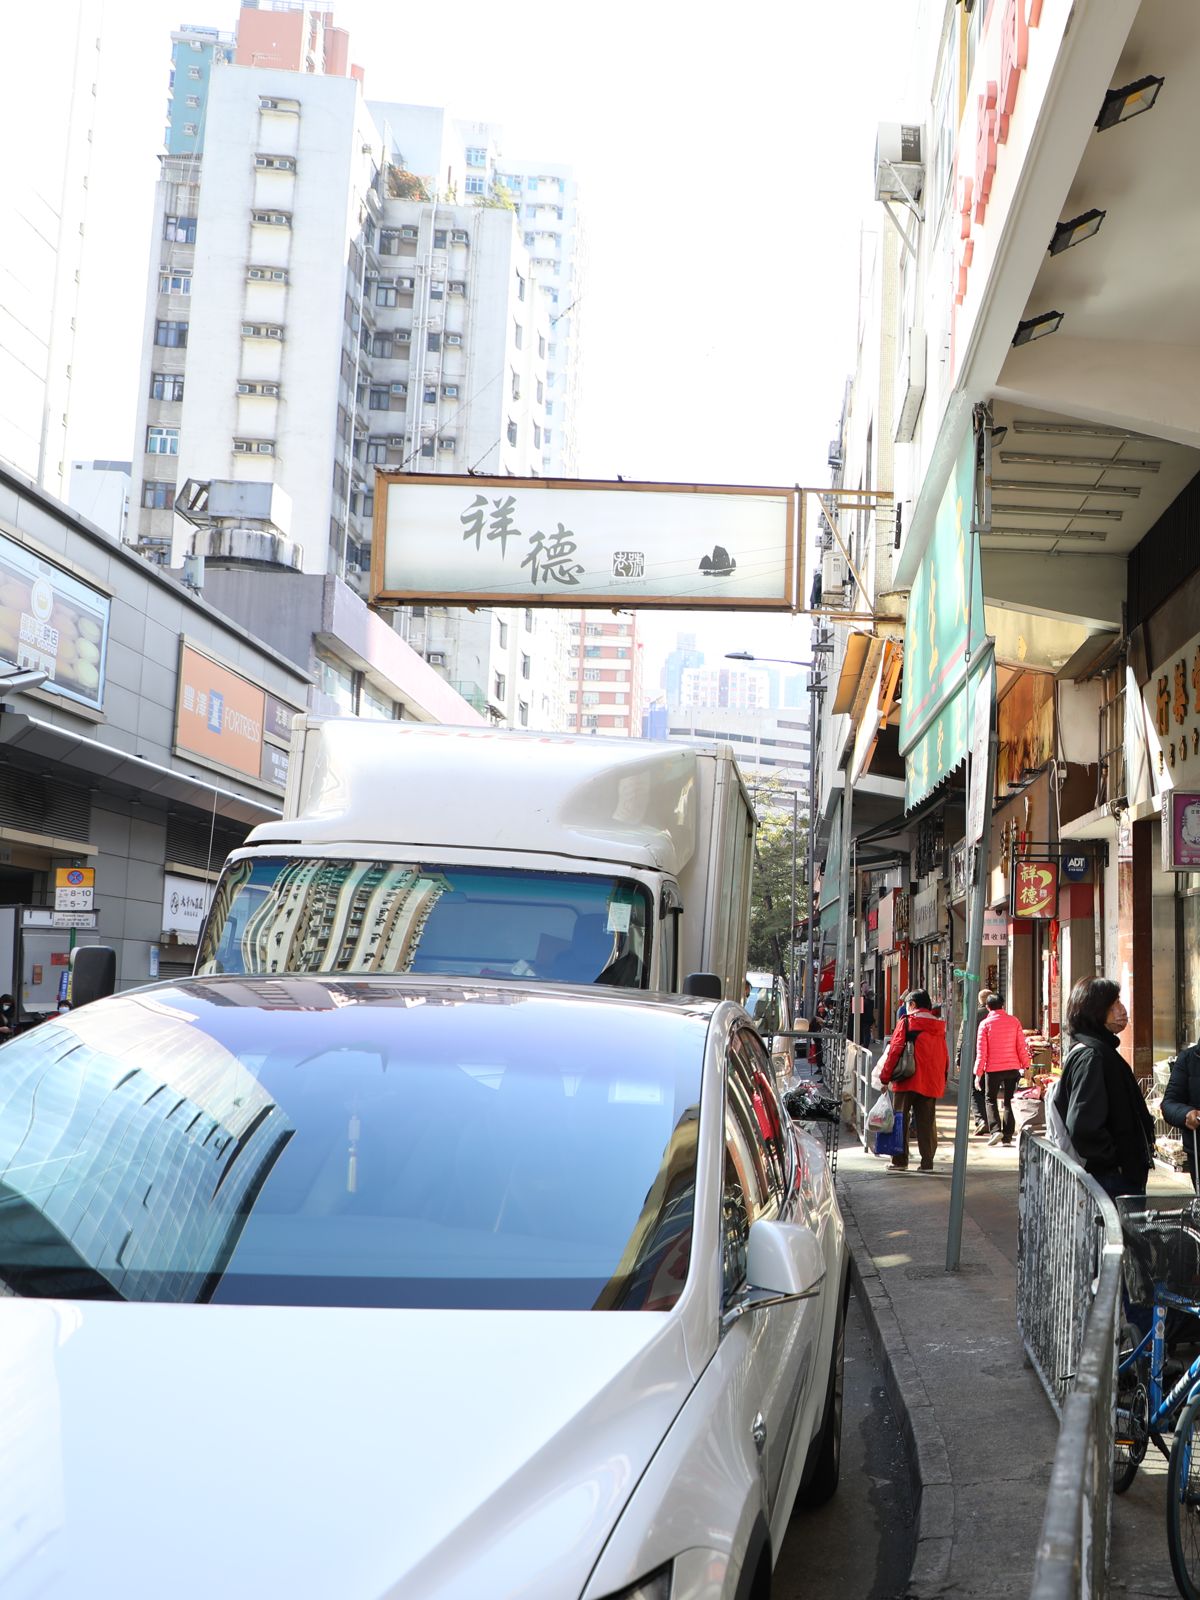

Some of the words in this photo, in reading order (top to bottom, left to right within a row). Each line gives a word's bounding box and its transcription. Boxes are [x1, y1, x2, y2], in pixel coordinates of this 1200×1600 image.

[460, 493, 586, 586] 祥德
[224, 706, 260, 742] FORTRESS
[1068, 858, 1085, 867] ADT
[70, 889, 92, 897] 8-10
[1020, 864, 1038, 905] 祥德
